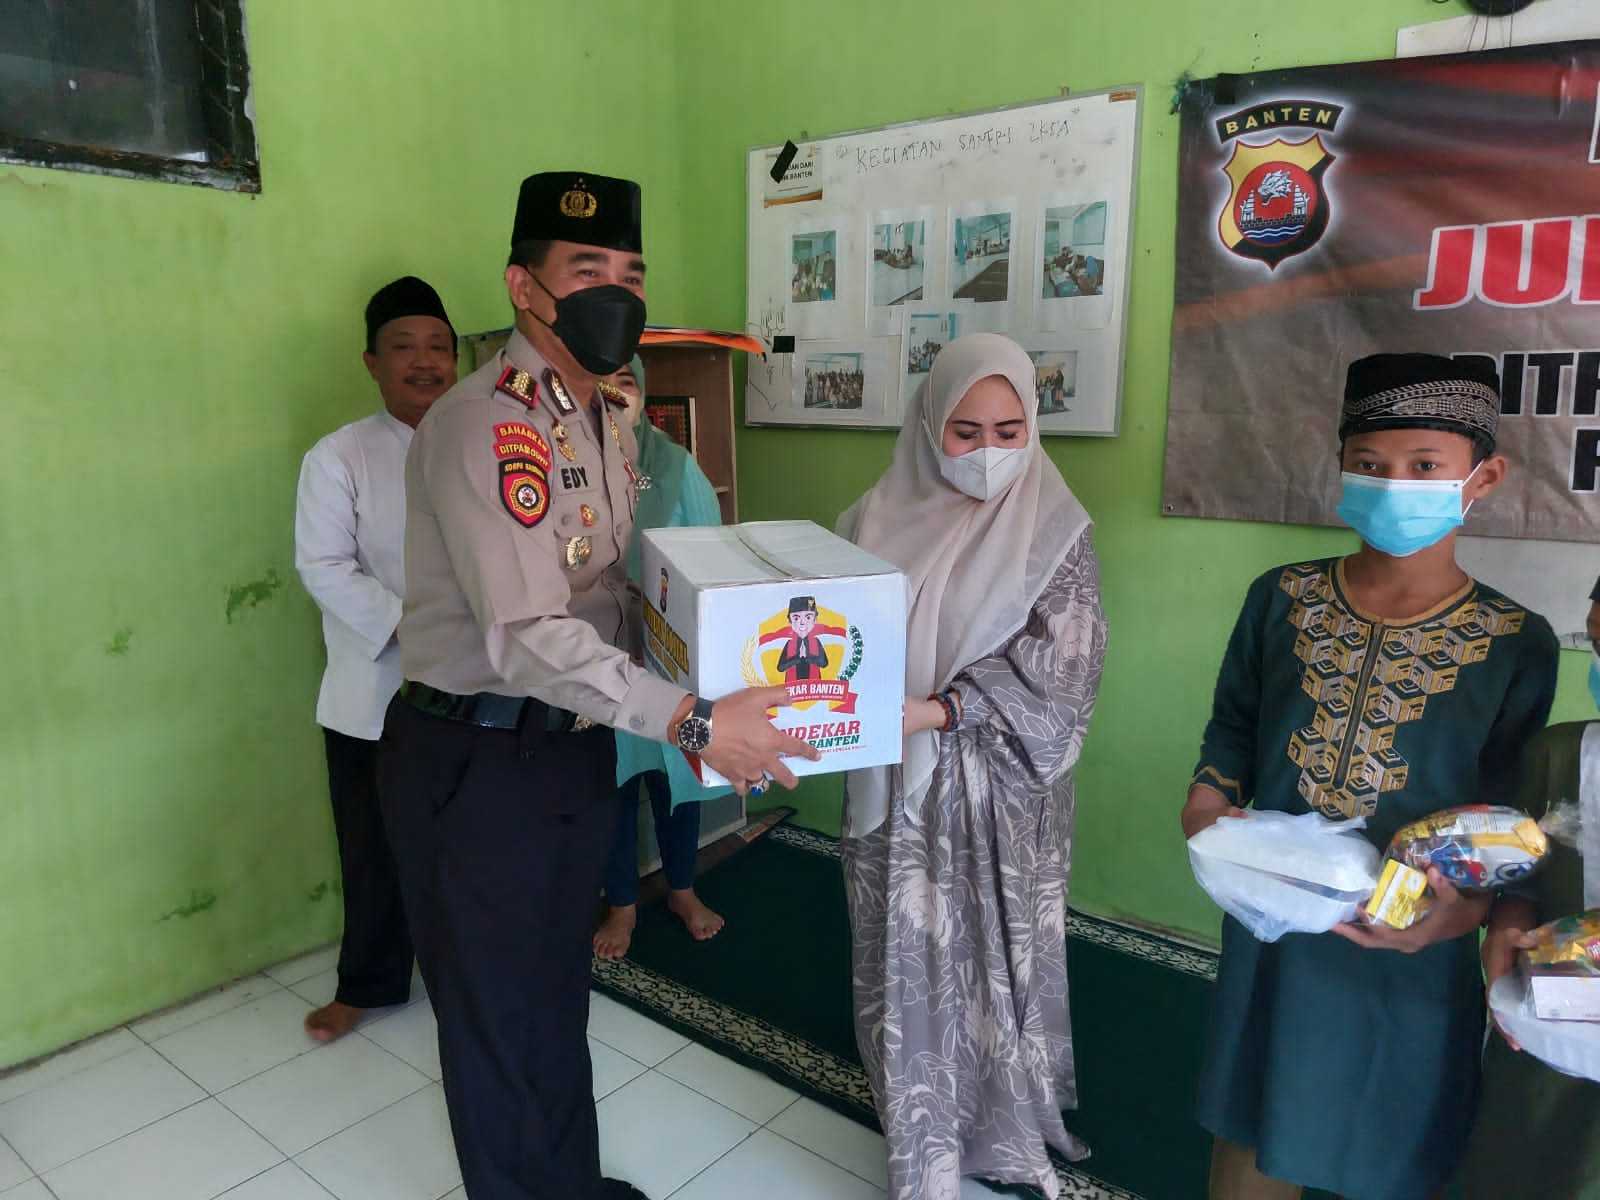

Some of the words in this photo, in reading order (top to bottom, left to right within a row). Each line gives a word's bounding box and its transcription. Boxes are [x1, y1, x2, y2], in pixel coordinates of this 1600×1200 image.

[1225, 107, 1332, 134] BANTEN
[561, 466, 588, 489] EDY
[785, 684, 807, 696] KAR
[809, 683, 845, 695] BANTEN
